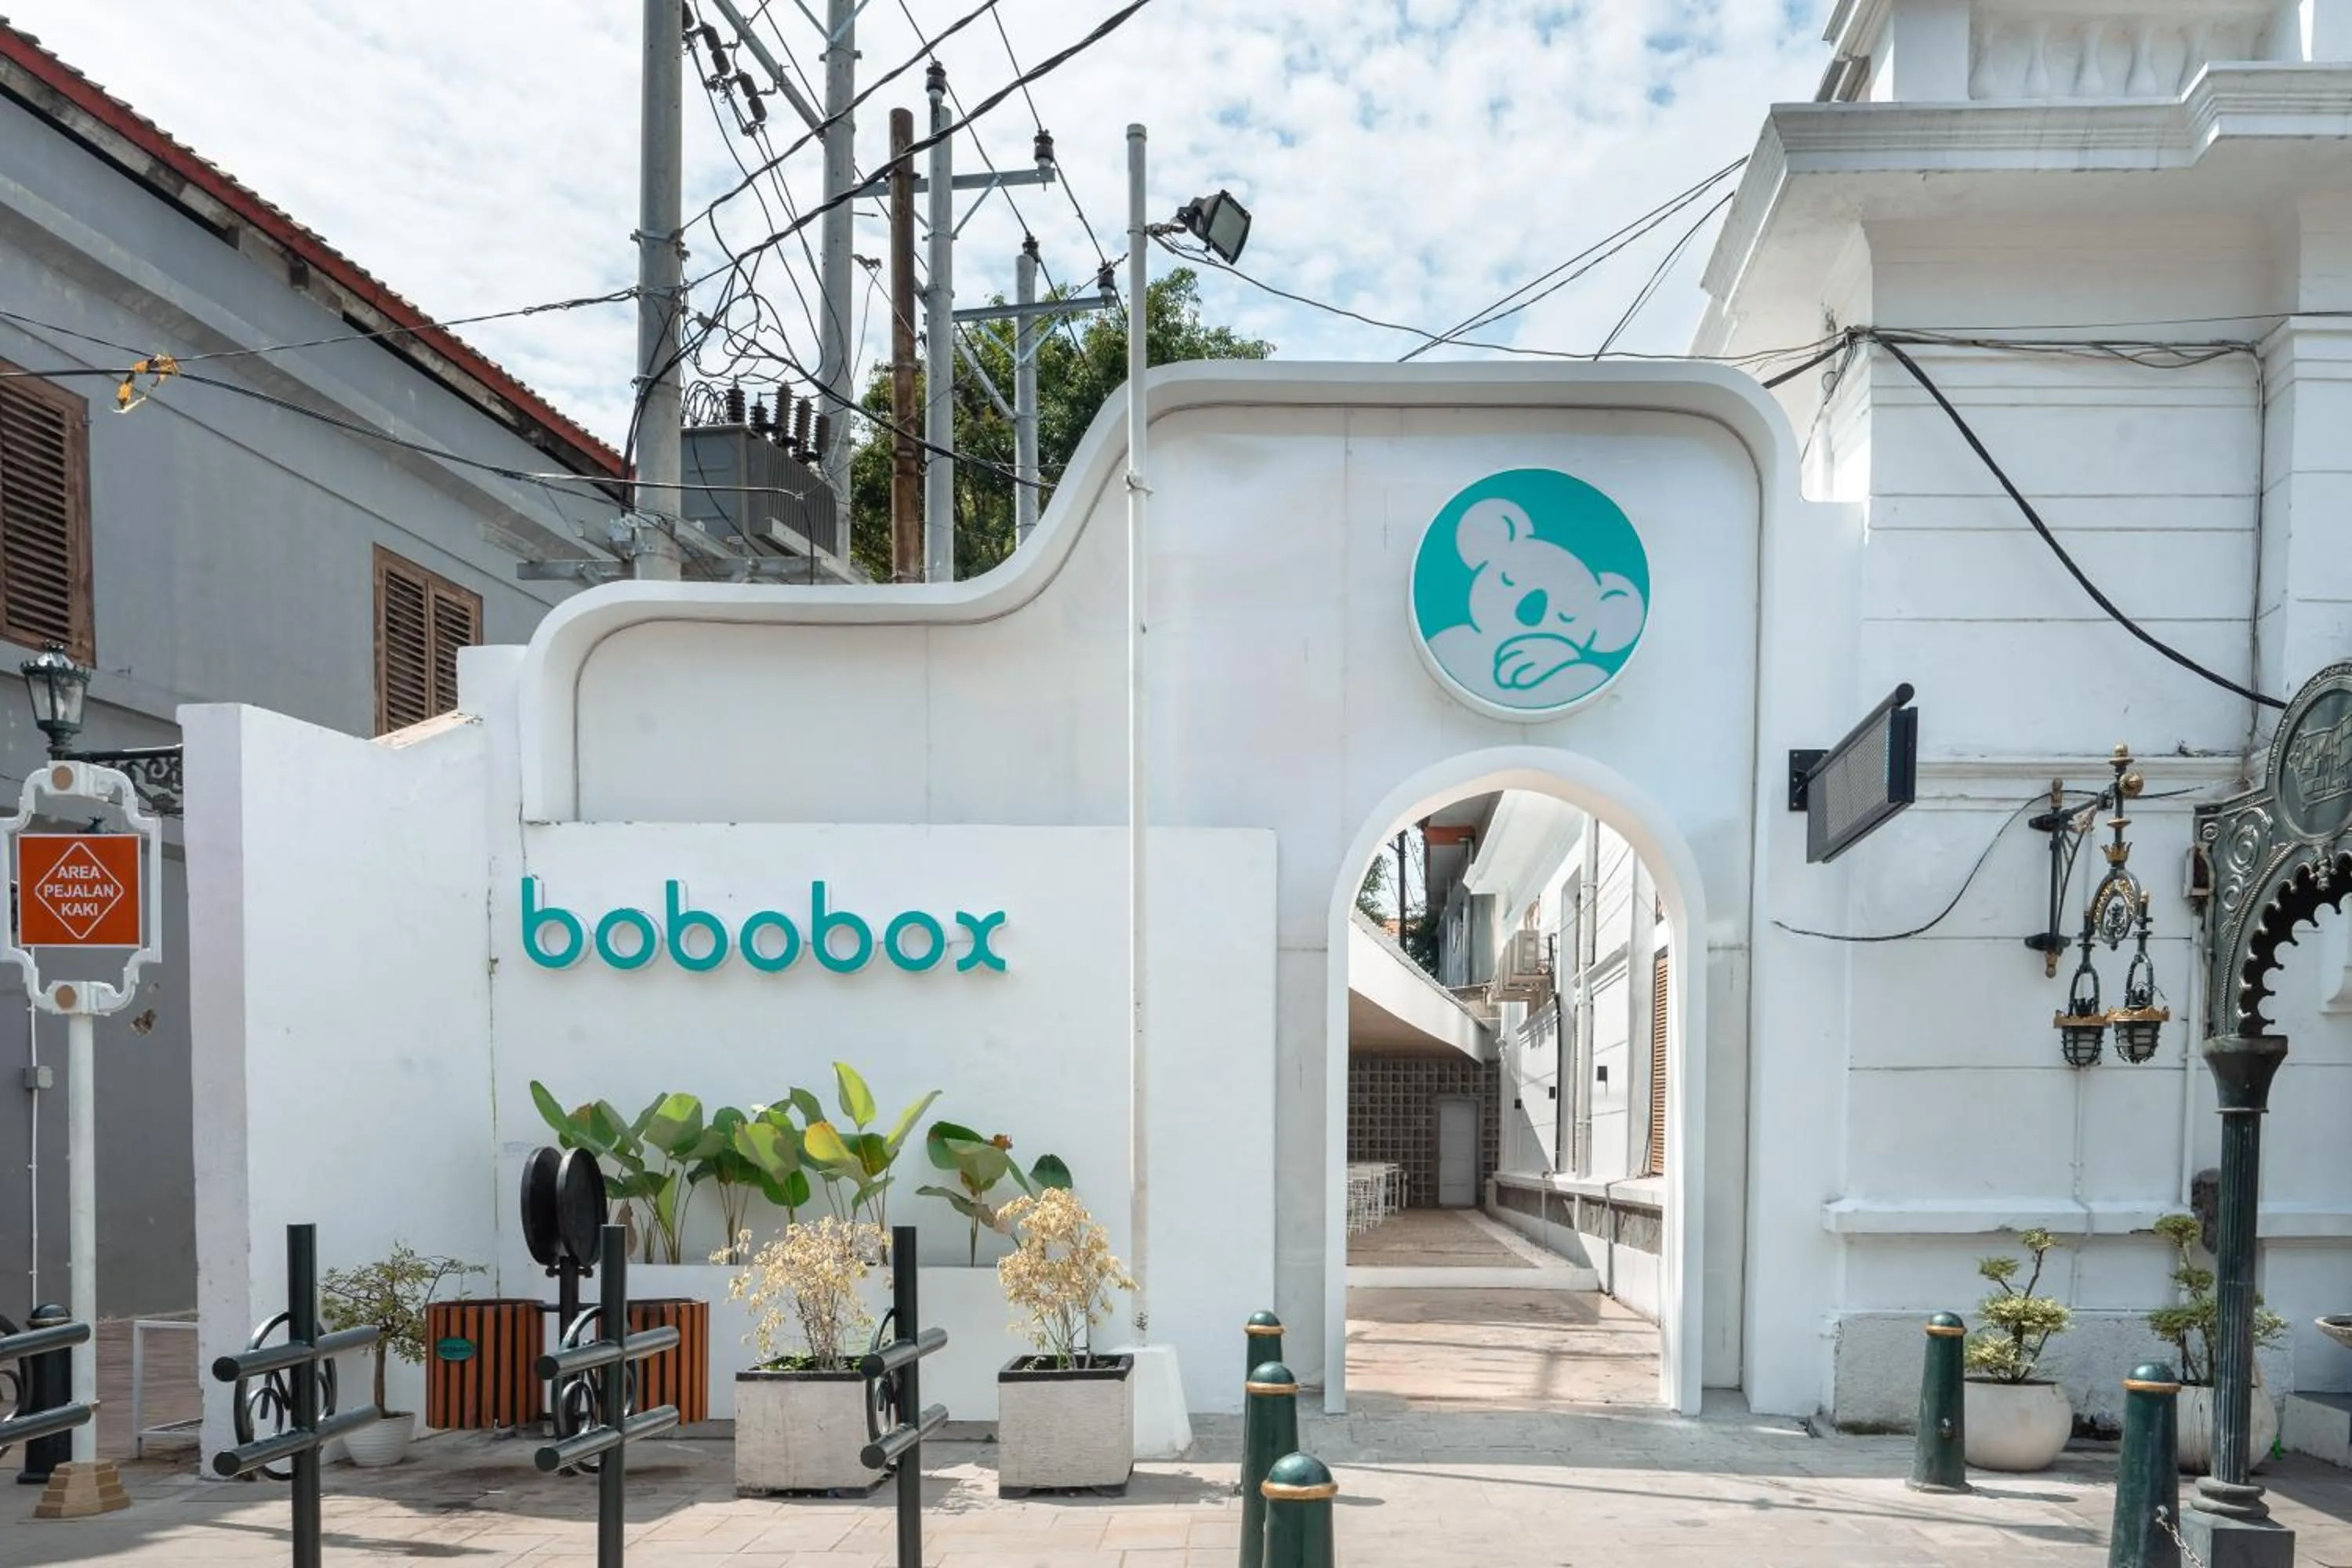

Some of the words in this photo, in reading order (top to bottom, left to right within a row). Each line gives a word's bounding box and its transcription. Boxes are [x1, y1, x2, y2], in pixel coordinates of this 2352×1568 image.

[58, 866, 100, 879] AREA
[44, 884, 114, 898] PEJALAN
[60, 902, 99, 916] KAKI
[521, 877, 1007, 973] bobobox
